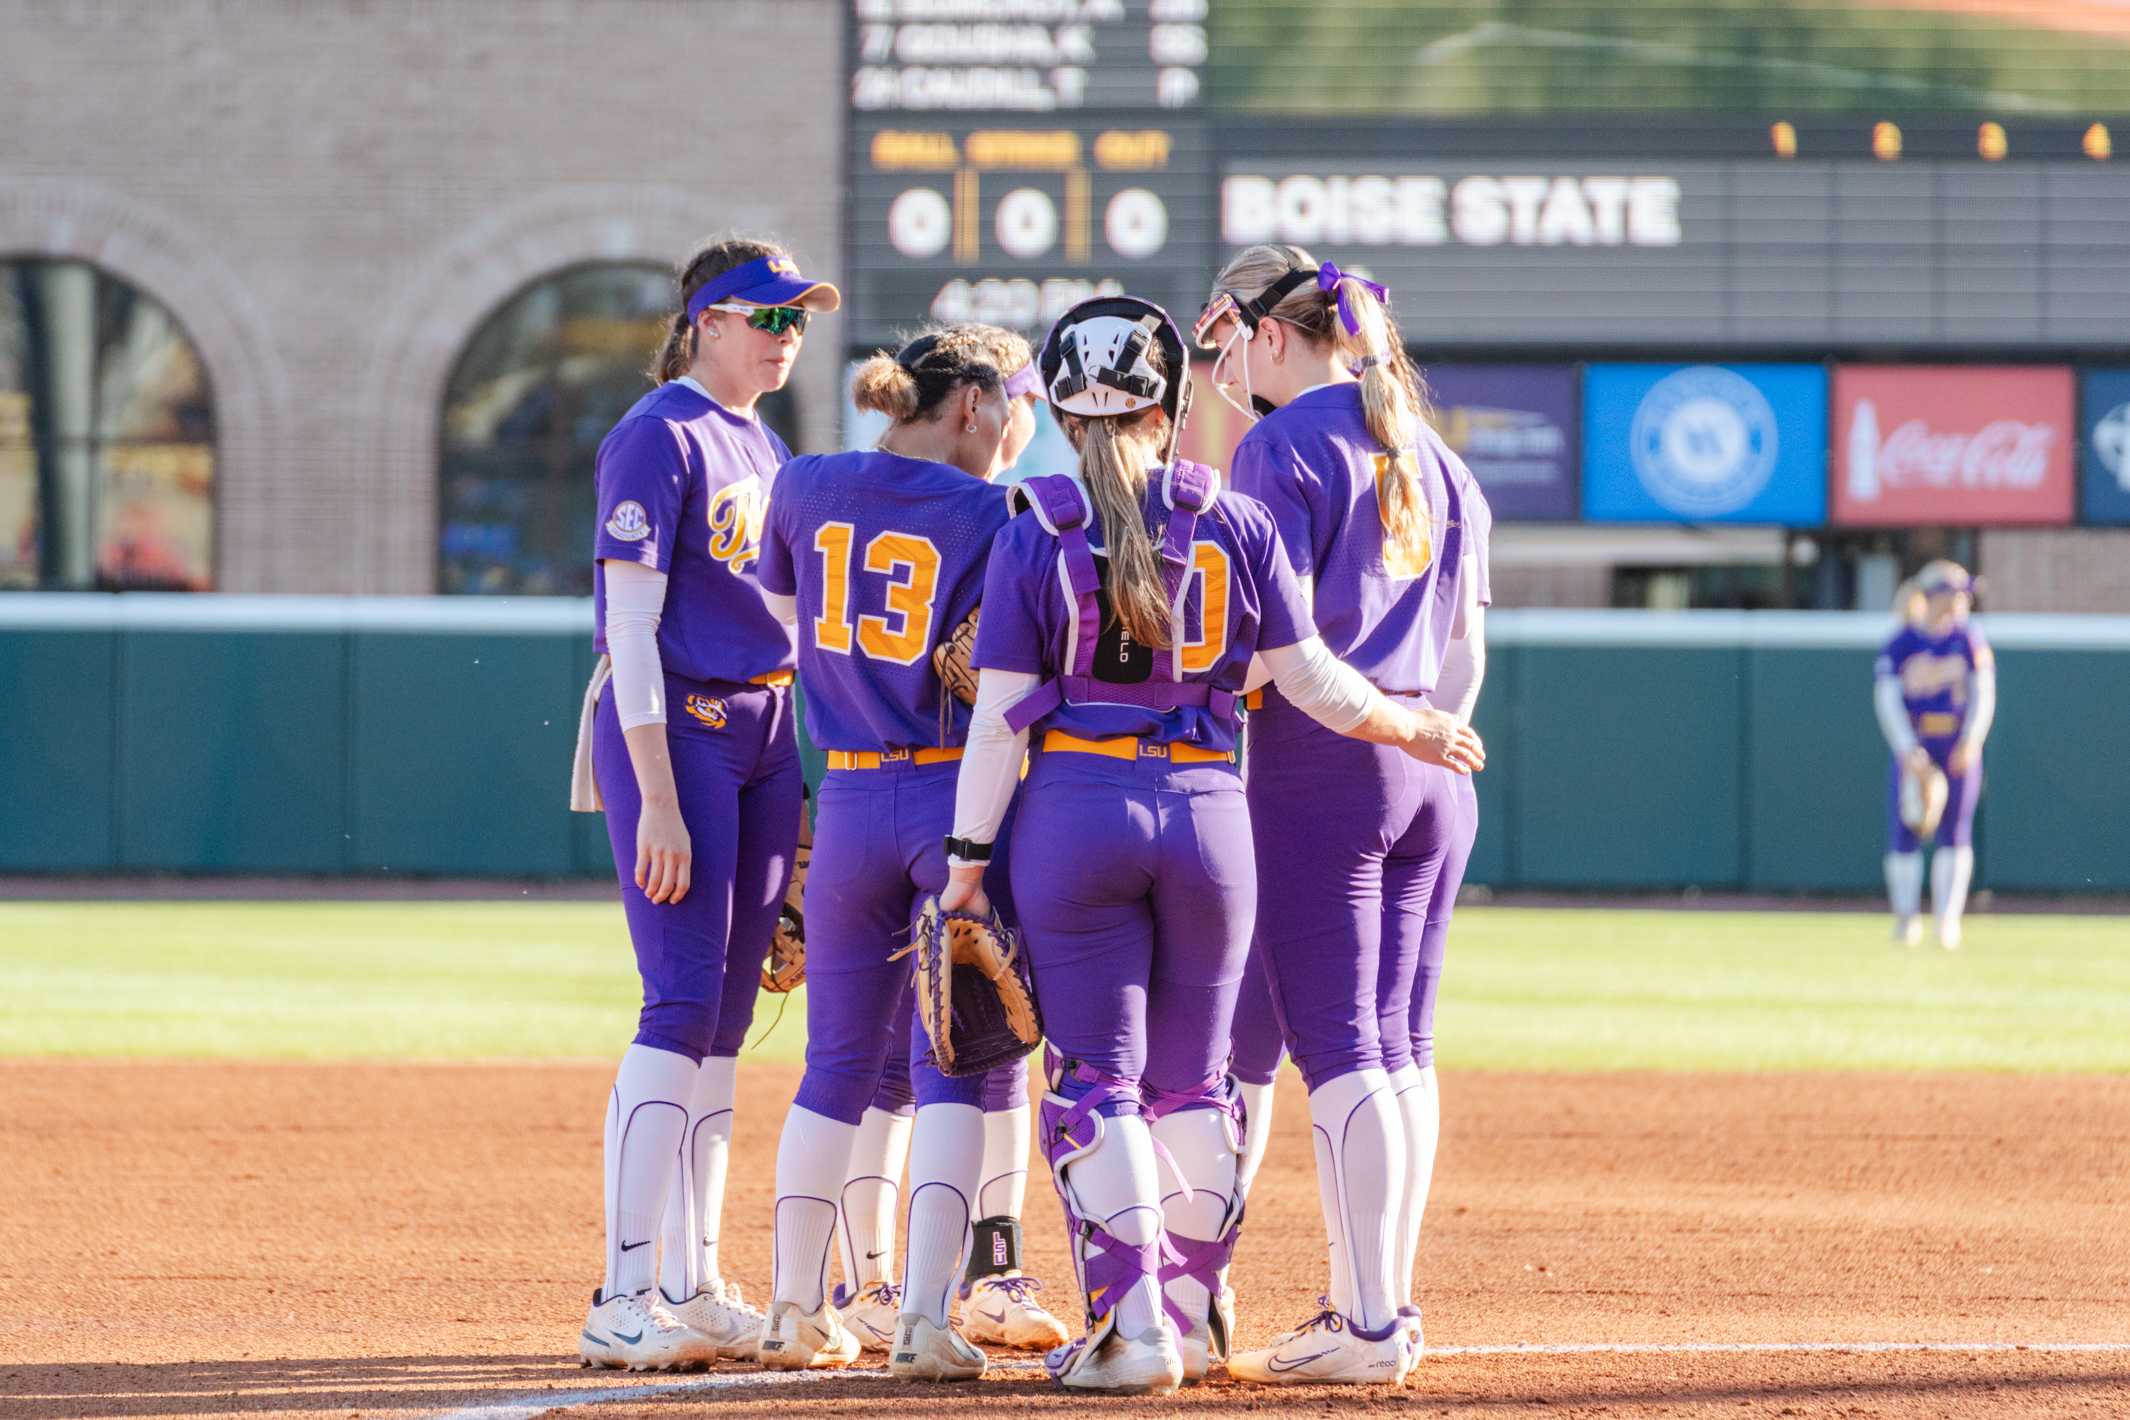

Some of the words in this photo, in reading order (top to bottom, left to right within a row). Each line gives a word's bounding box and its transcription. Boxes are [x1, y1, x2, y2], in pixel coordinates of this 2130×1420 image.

[889, 187, 951, 259] 0
[995, 187, 1057, 259] 0
[1105, 187, 1168, 259] 0
[1222, 175, 1447, 244] BOISE
[1451, 175, 1682, 246] STATE
[616, 503, 643, 531] SEC
[814, 521, 942, 666] 13
[880, 748, 910, 763] LSU
[1138, 743, 1168, 759] LSU
[992, 1231, 1008, 1267] LSU
